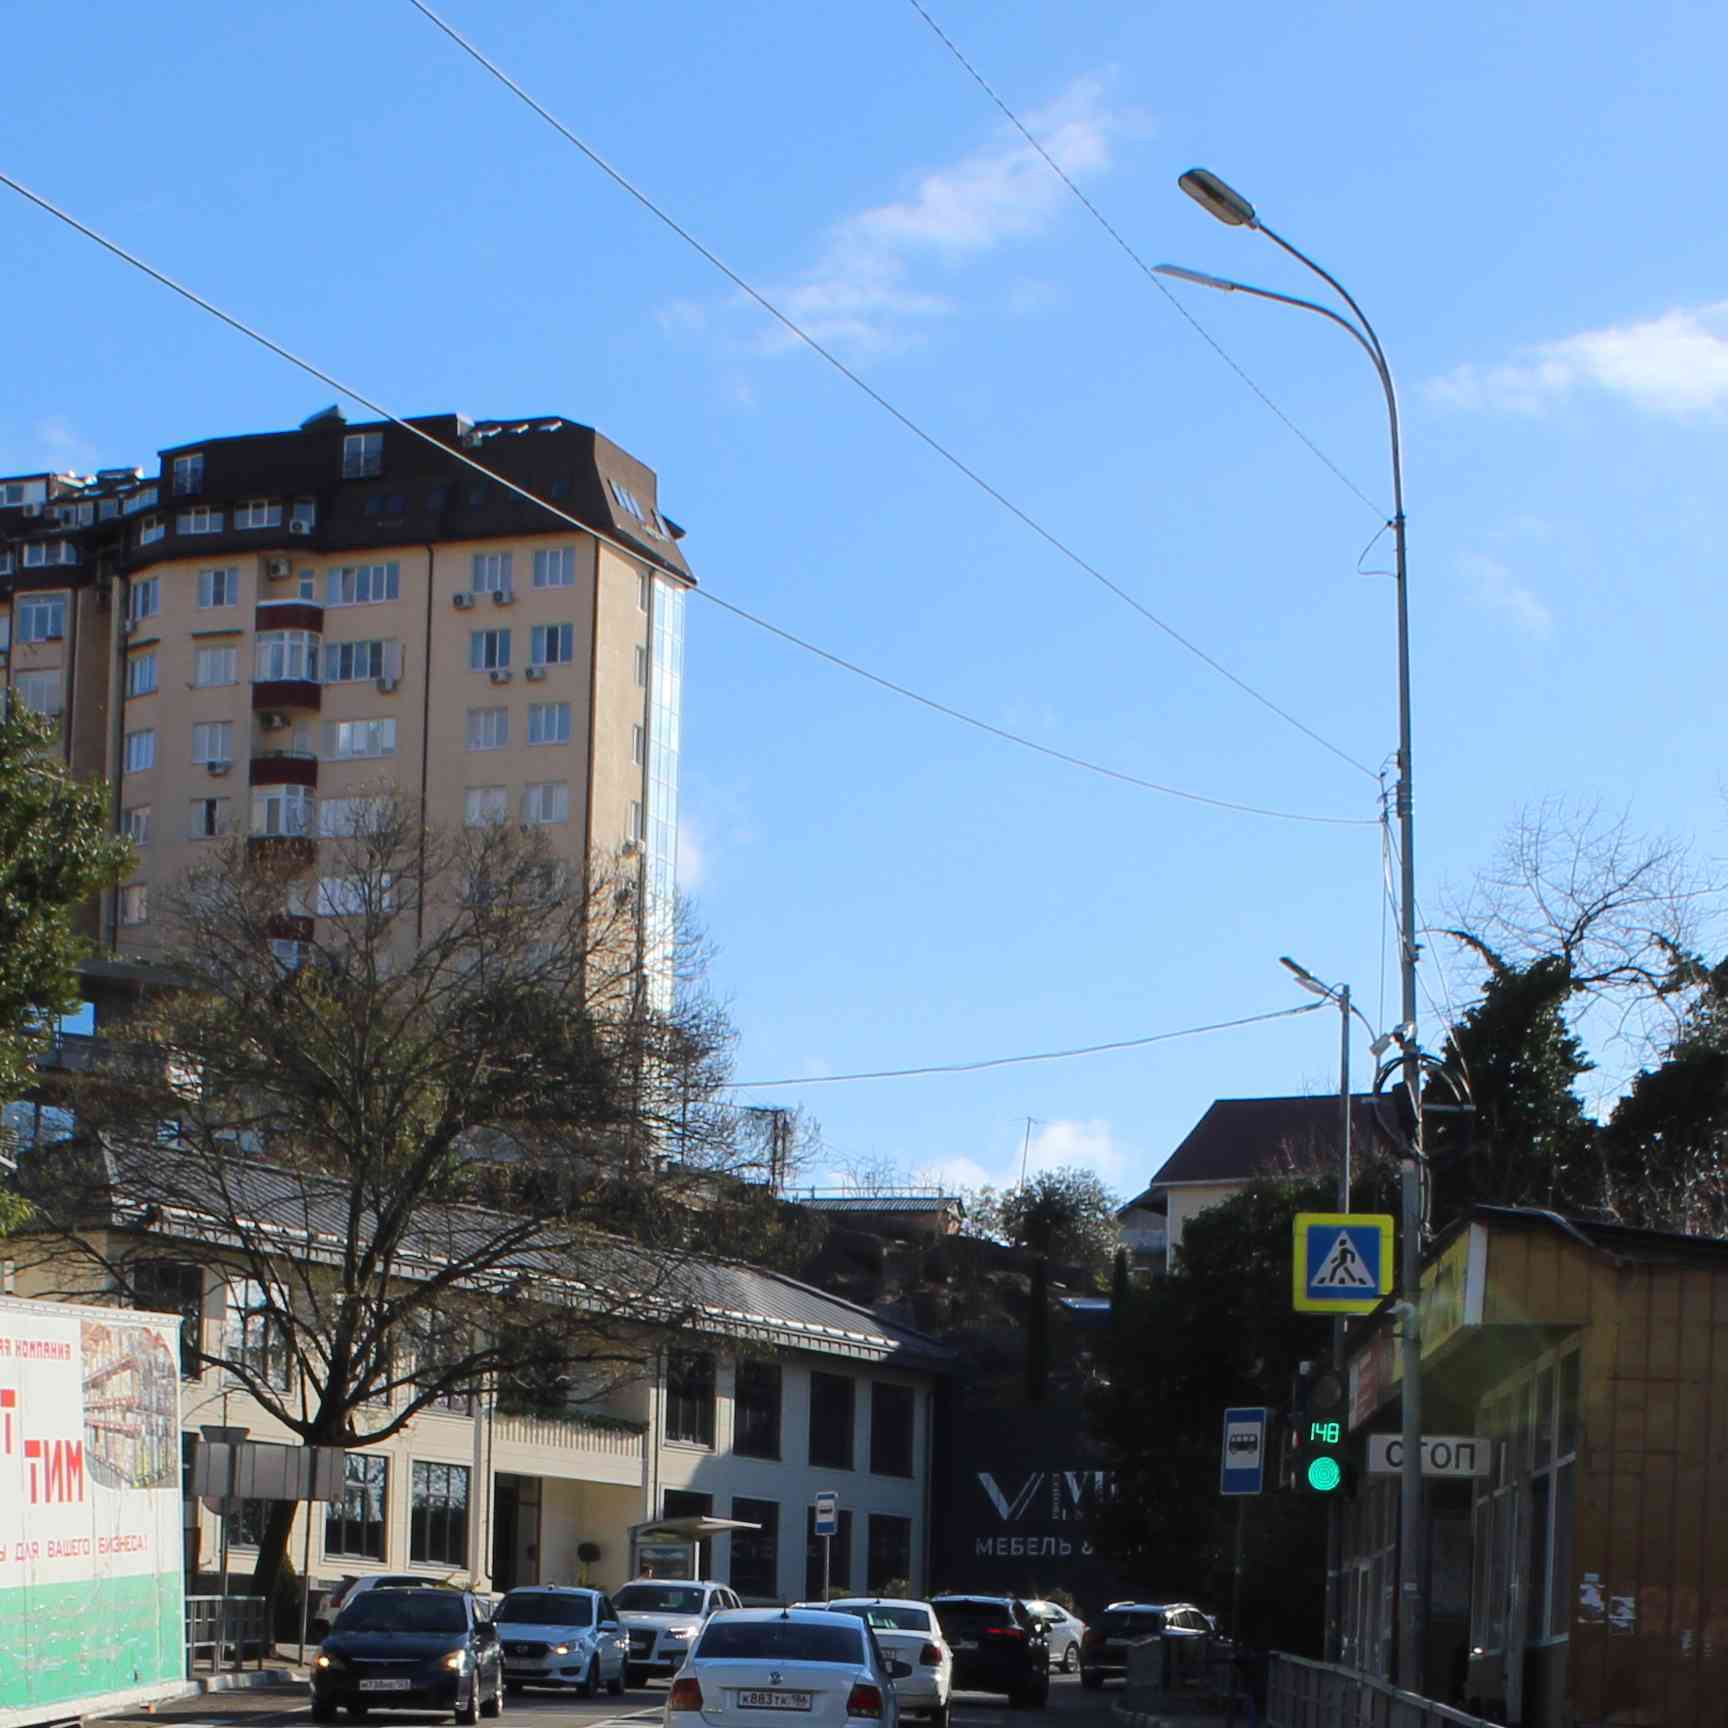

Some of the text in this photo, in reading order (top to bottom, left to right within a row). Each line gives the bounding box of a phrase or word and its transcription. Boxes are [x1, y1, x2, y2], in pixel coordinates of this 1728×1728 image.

[16, 1339, 72, 1361] КОМПАНИЯ
[1310, 1423, 1340, 1444] 148
[24, 1440, 84, 1504] ТИМ
[15, 1542, 40, 1562] ДЛЯ
[48, 1538, 90, 1558] ВАШЕГО
[98, 1535, 148, 1555] БИЗНЕСА!
[976, 1537, 1072, 1556] МЕБЕЛЬ
